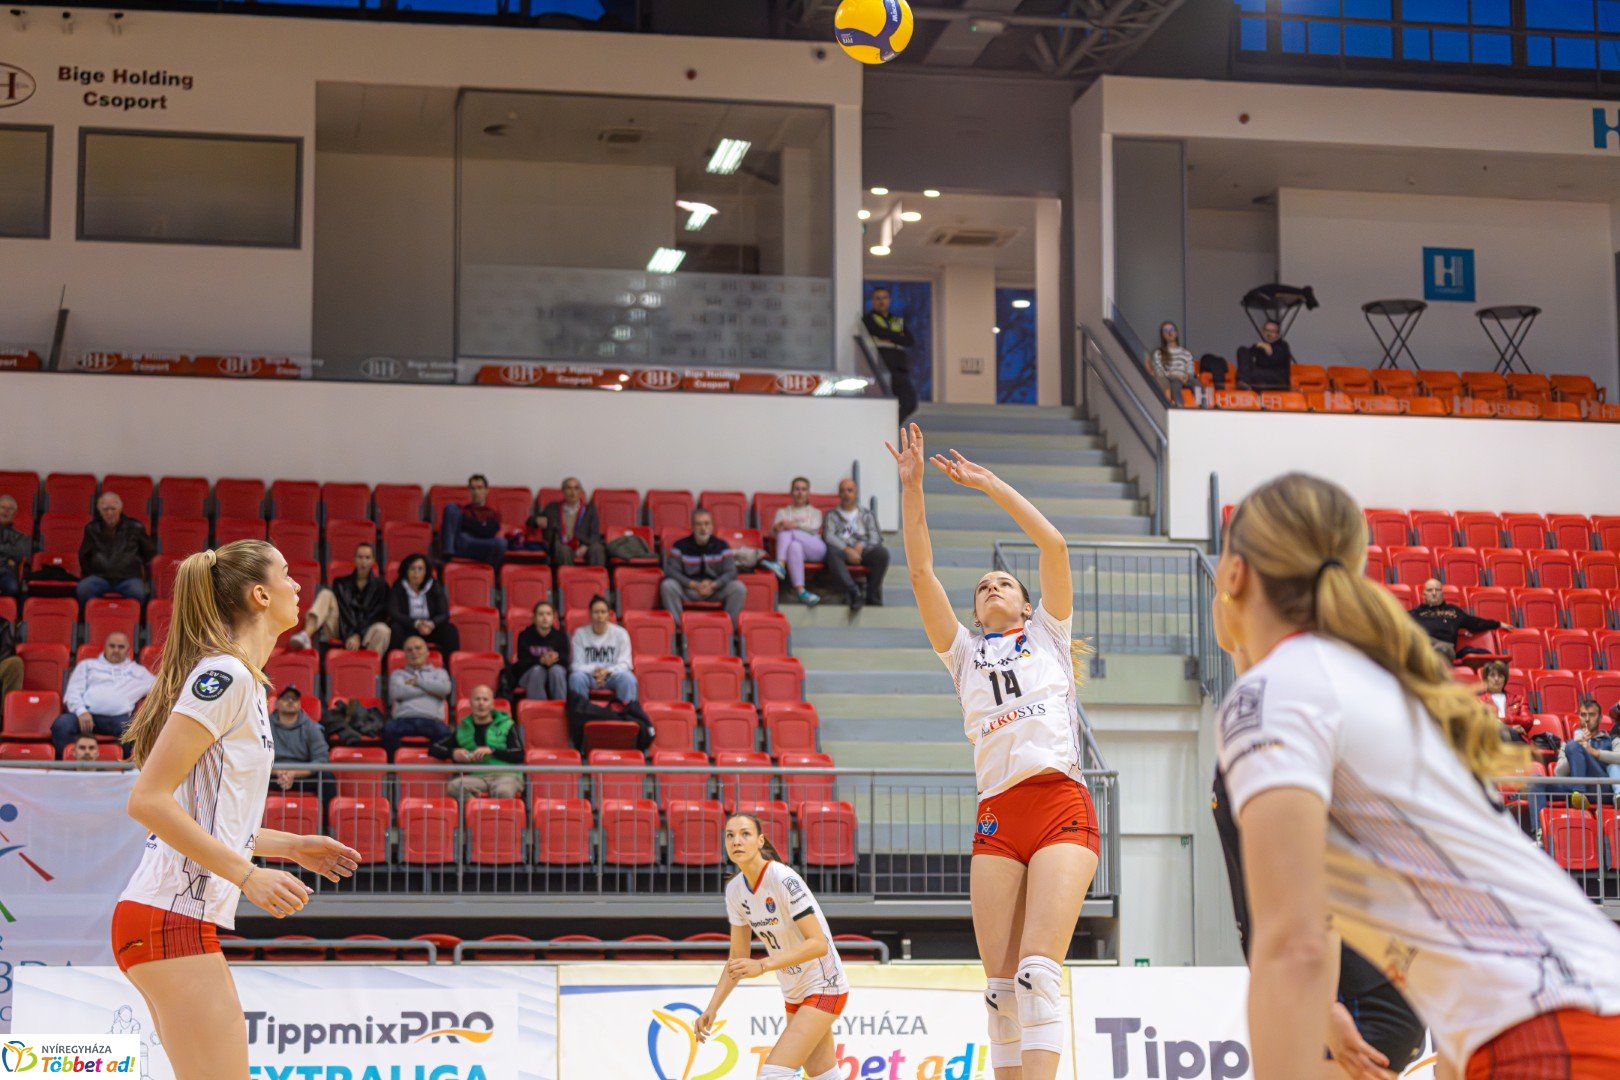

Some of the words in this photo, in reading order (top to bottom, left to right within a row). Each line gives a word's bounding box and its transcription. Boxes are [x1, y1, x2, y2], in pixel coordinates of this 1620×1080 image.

[57, 66, 105, 85] Bige
[112, 69, 194, 90] Holding
[83, 91, 168, 111] Csoport
[585, 646, 616, 665] TOMMY
[989, 669, 1022, 706] 14
[244, 1010, 494, 1054] TippmixPRO
